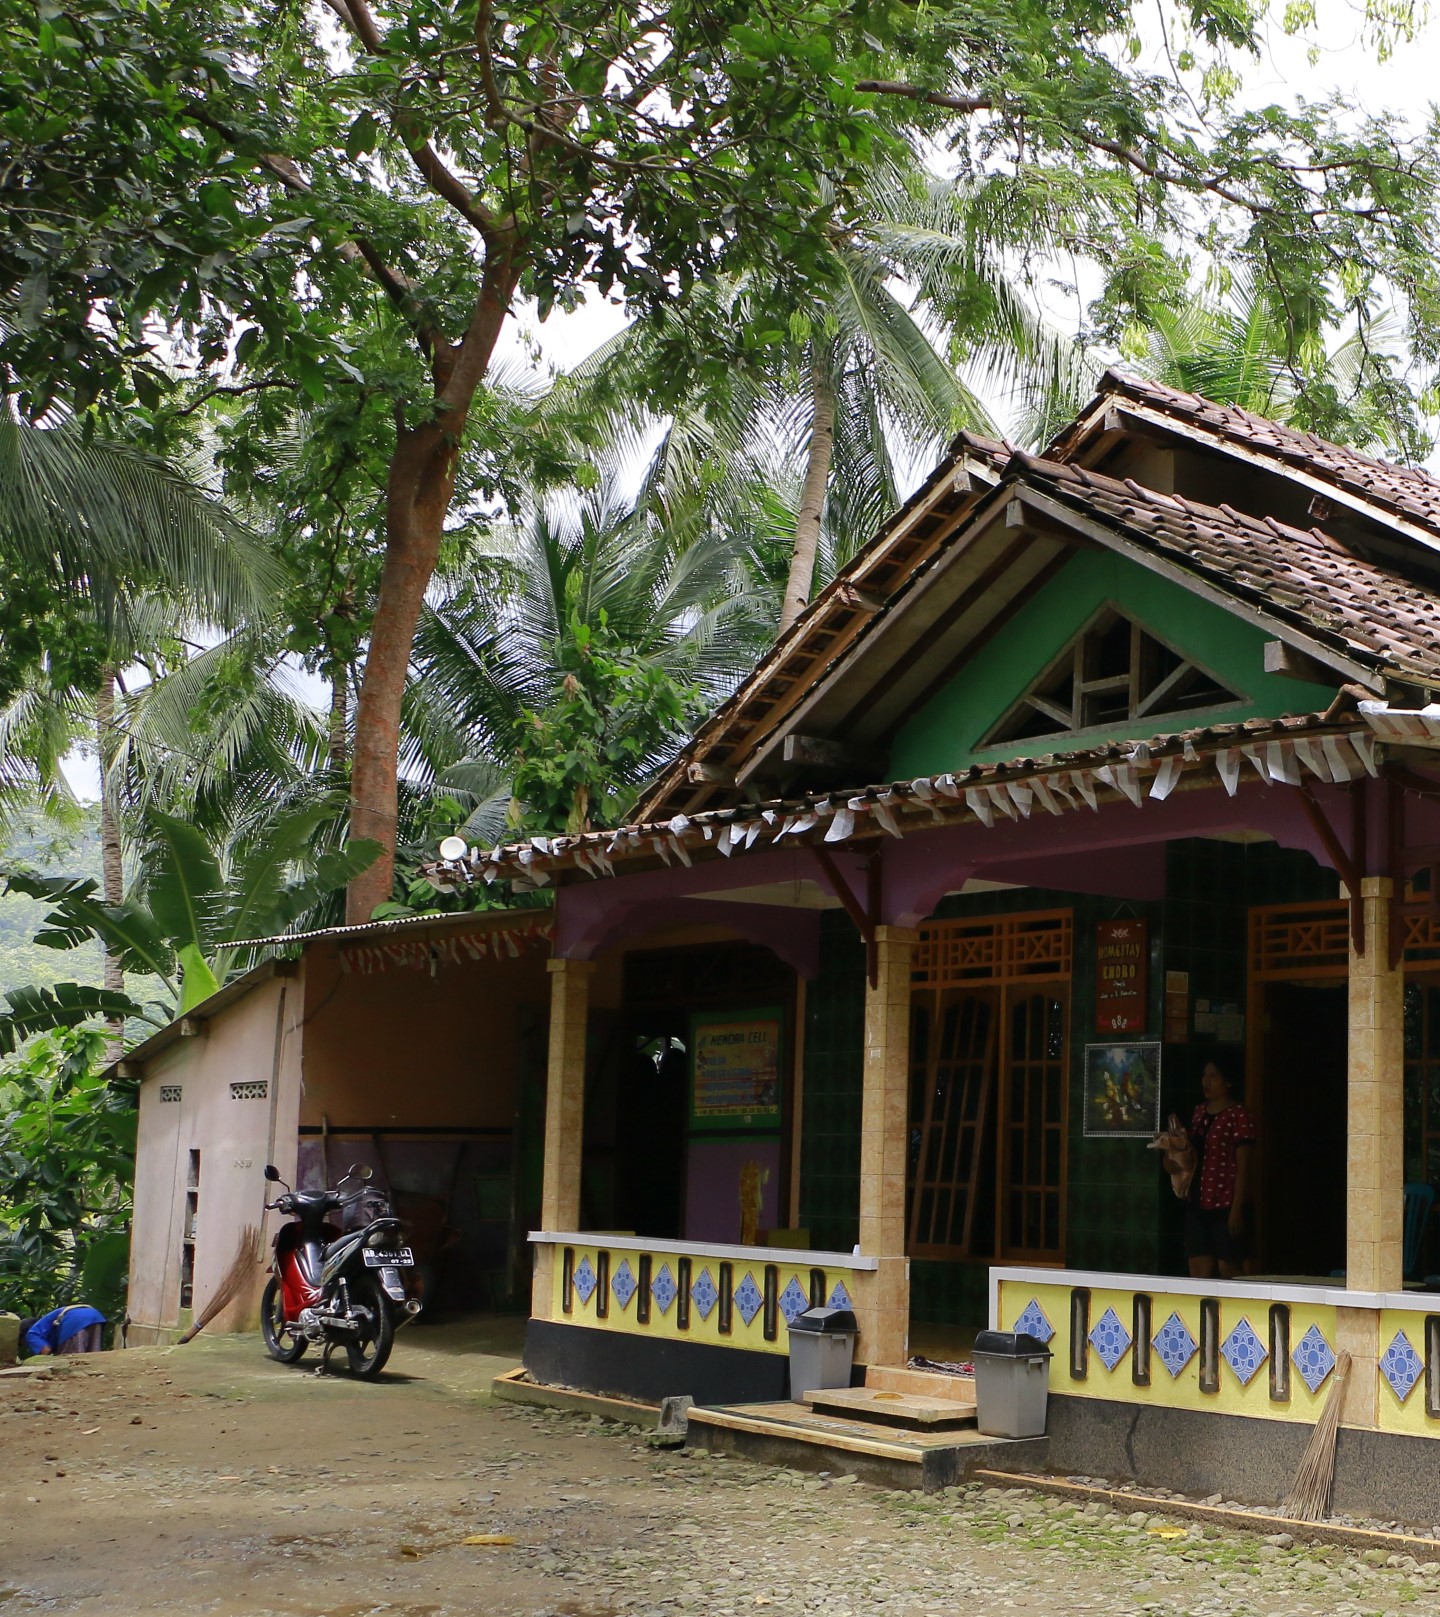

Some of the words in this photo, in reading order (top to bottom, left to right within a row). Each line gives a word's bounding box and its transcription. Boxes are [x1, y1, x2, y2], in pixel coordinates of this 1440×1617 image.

[1097, 943, 1141, 960] HOMESTAY
[1103, 964, 1136, 980] ENDRO
[711, 1033, 744, 1046] HENDRA
[748, 1031, 768, 1043] CELL
[365, 1249, 375, 1258] AB
